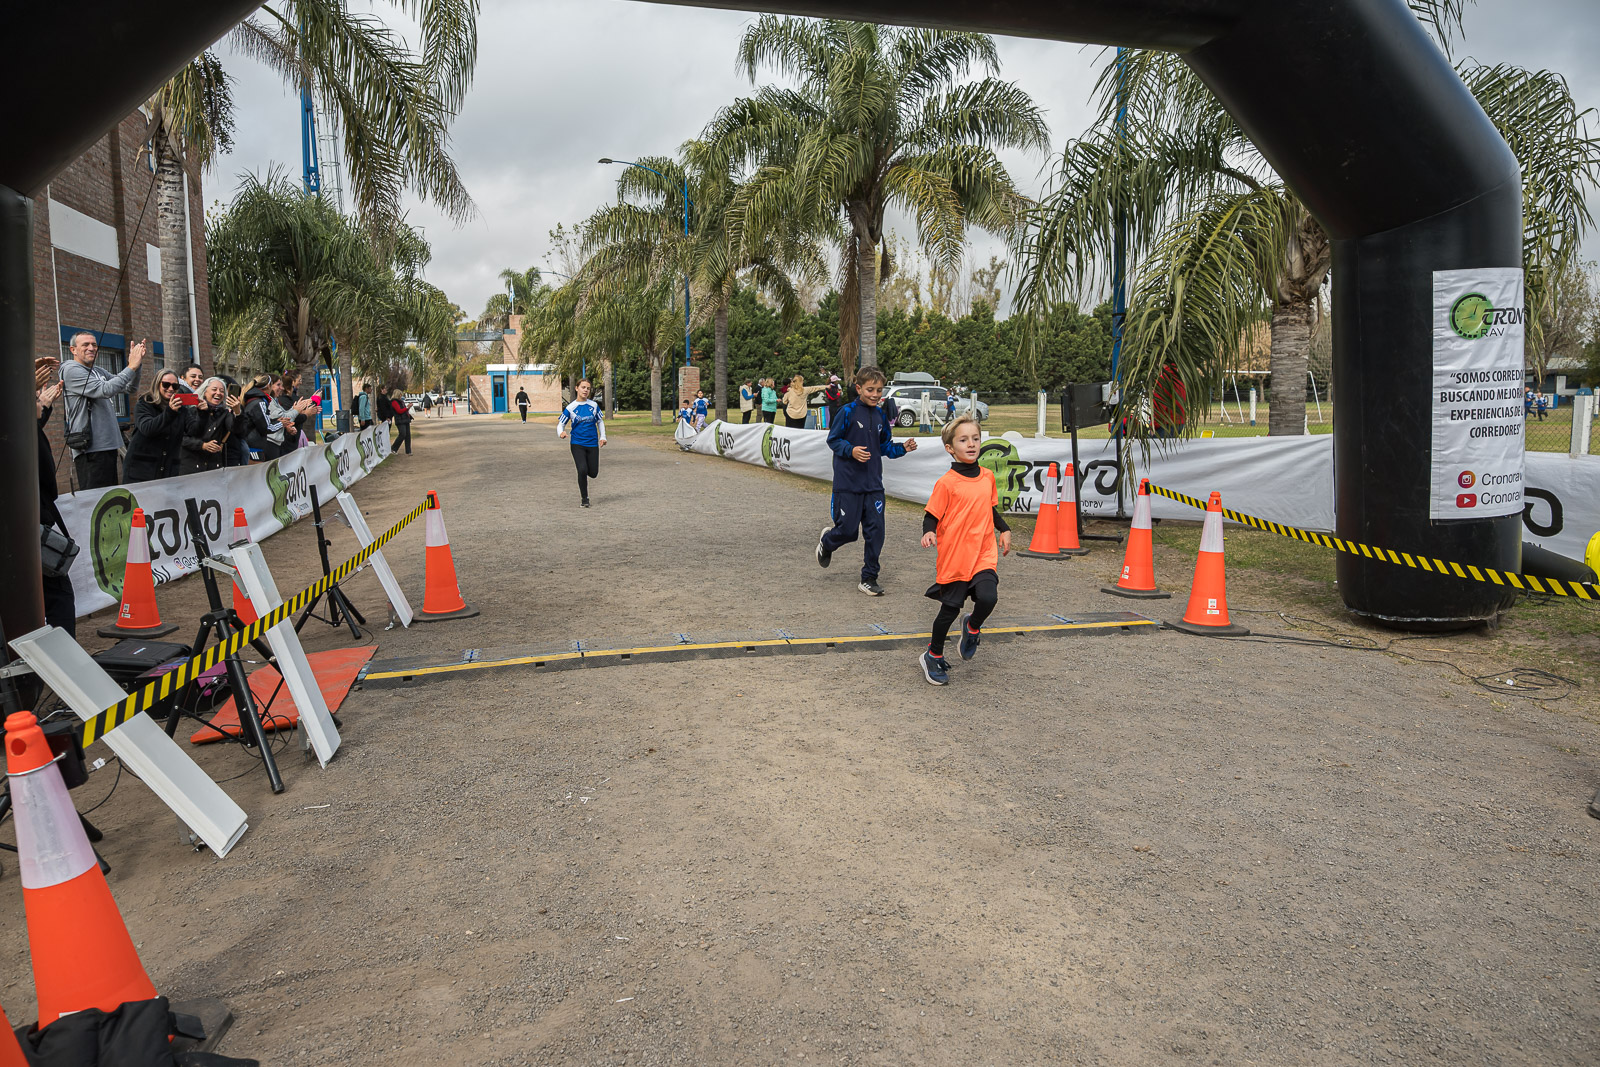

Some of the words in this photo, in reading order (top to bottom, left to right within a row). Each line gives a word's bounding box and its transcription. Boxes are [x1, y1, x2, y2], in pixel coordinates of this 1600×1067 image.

[1481, 328, 1505, 337] RAV
[1492, 369, 1524, 382] CORREDO
[1440, 389, 1495, 403] BUSCANDO
[1451, 407, 1514, 421] EXPERIENCIAS
[1514, 406, 1521, 417] DE
[1003, 497, 1032, 512] RAV
